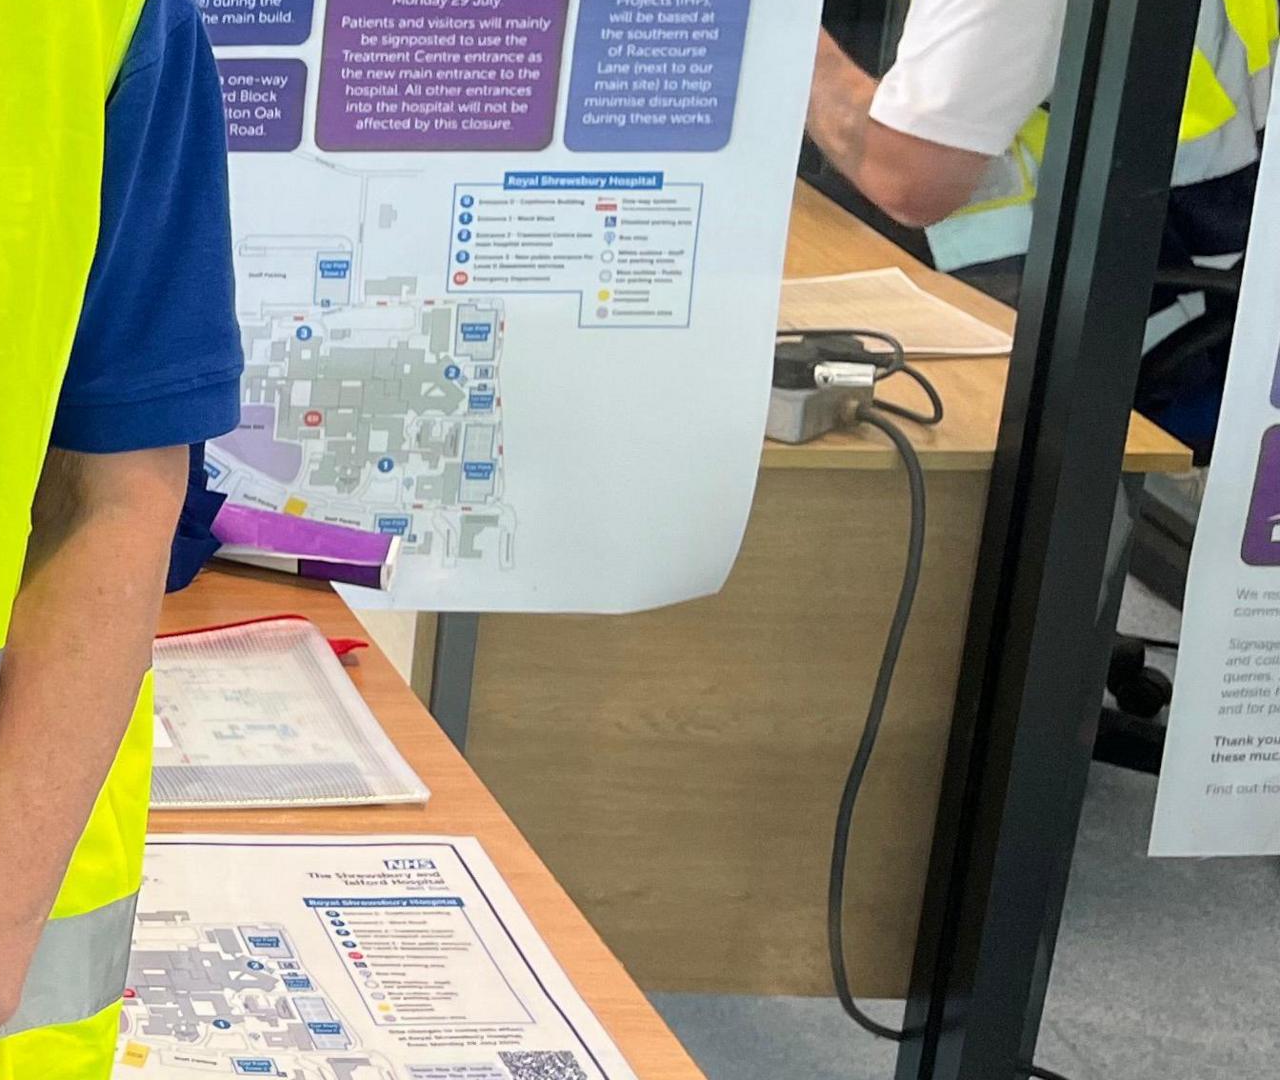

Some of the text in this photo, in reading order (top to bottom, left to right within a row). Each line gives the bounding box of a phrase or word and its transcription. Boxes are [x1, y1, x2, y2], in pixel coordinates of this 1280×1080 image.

[341, 15, 551, 32] Patients and visitors will mainly
[228, 76, 288, 91] one-way
[508, 175, 657, 188] Royal Shrewsbury Hospital
[1214, 735, 1254, 747] Thank
[1211, 752, 1246, 764] these
[387, 859, 435, 870] NHS
